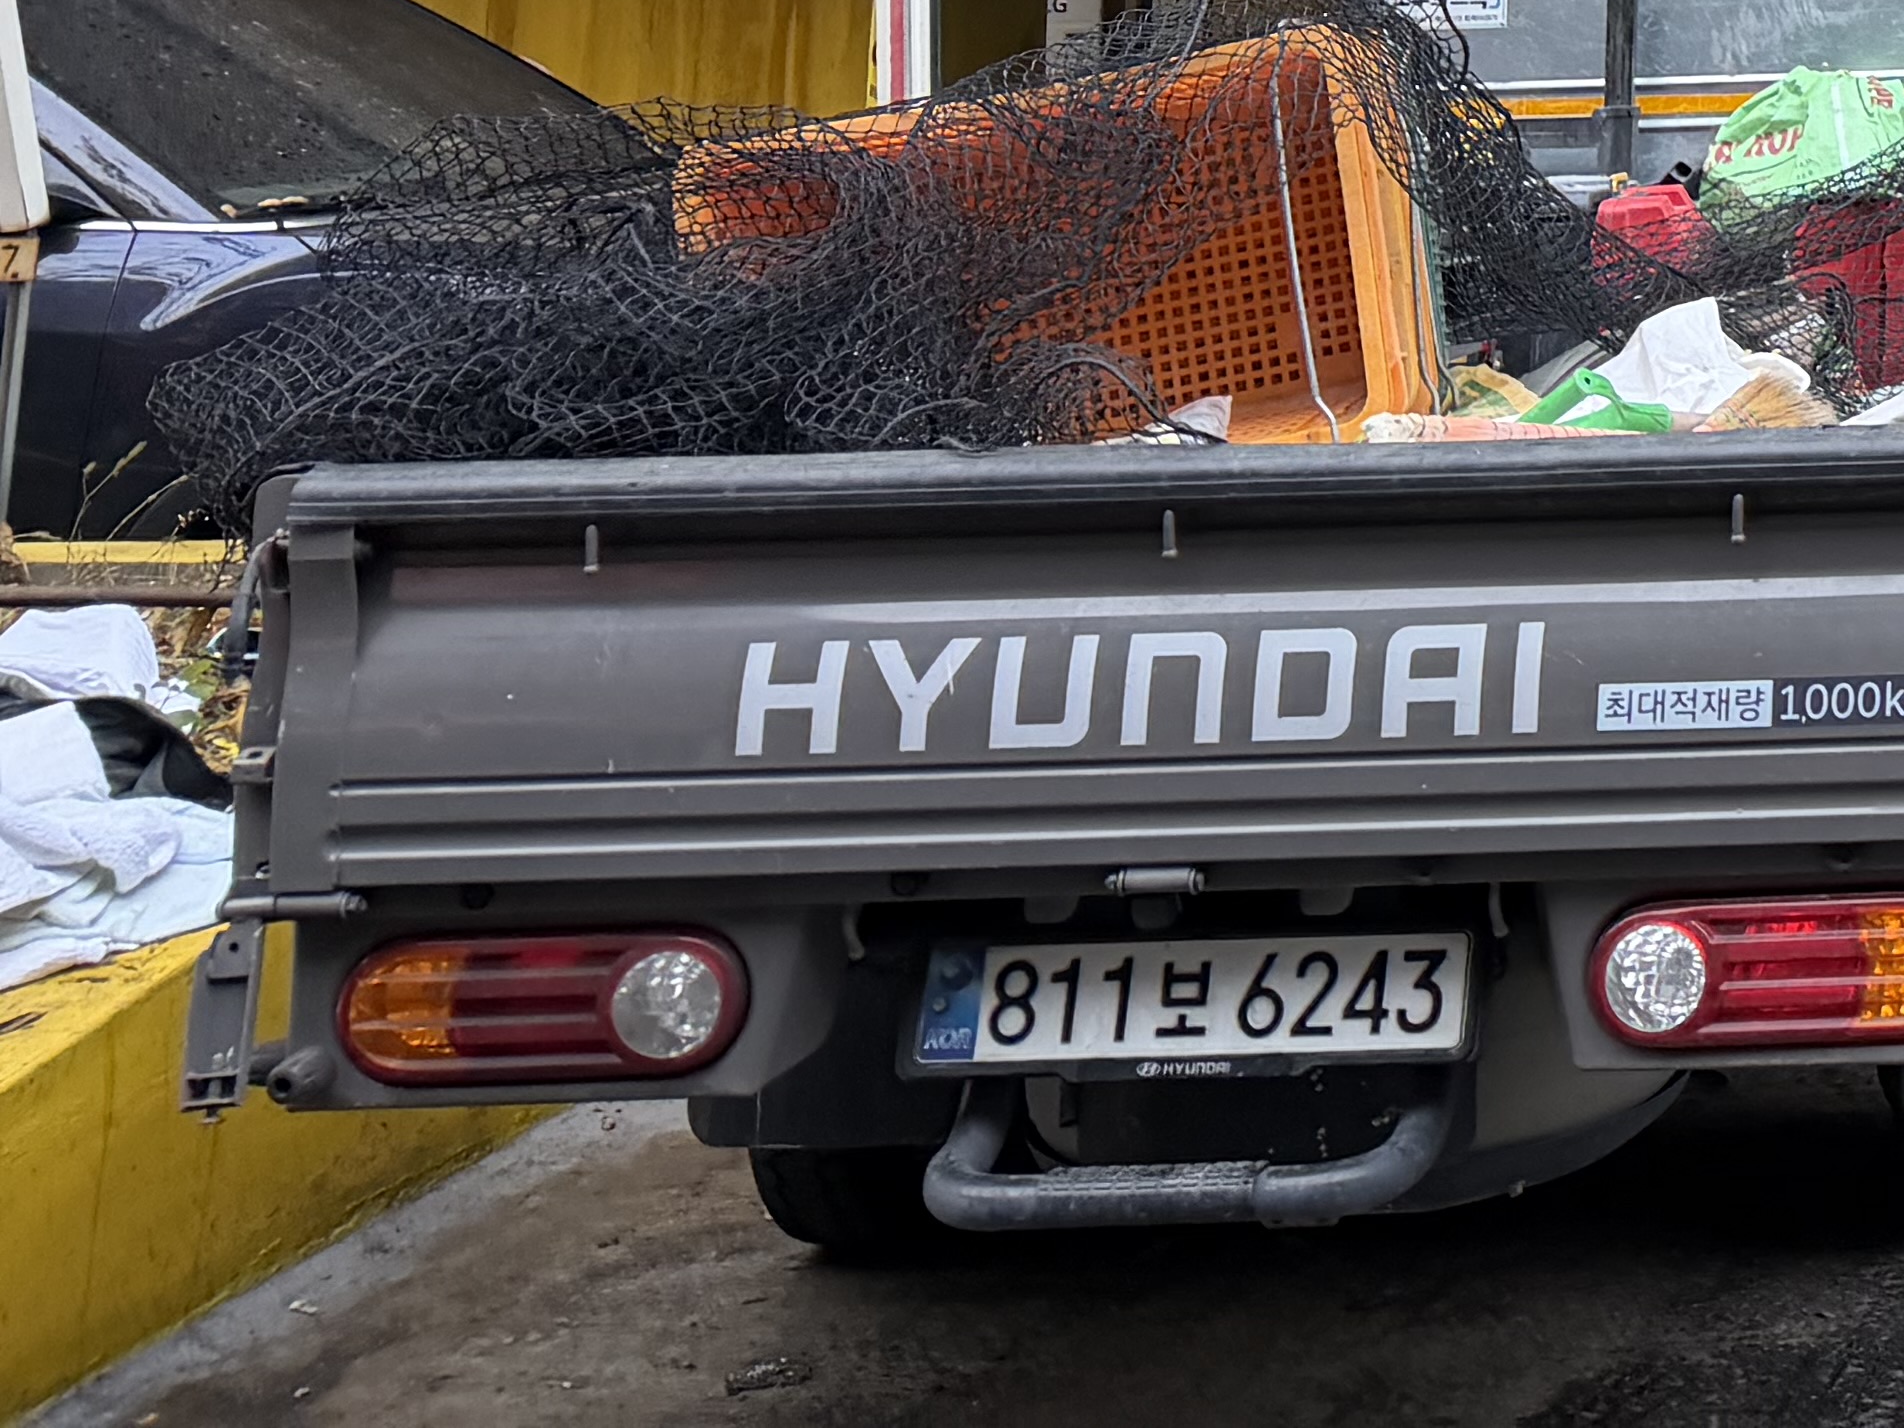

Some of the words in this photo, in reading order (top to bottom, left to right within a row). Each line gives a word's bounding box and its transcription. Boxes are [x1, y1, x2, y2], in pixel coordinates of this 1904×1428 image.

[735, 622, 1545, 756] HYUNDAI
[1604, 688, 1766, 725] 최대적재량
[1238, 948, 1449, 1039] 6243
[1163, 1061, 1231, 1076] HYUNDAI
